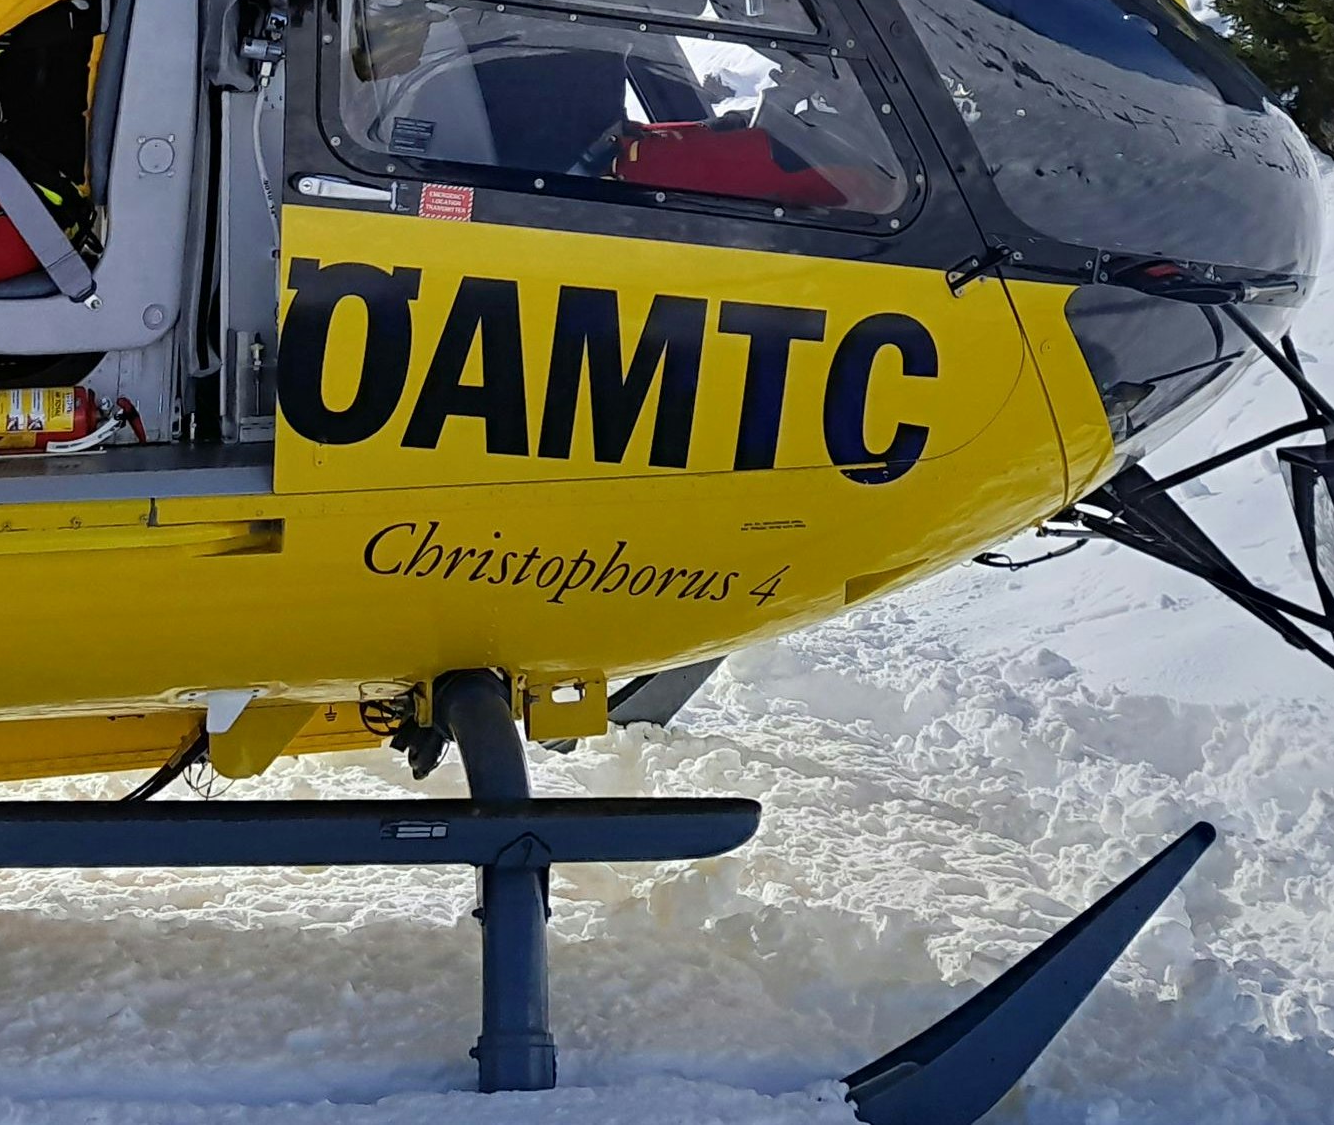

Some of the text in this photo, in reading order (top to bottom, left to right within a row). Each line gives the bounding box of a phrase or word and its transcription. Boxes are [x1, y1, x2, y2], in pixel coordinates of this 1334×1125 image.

[431, 198, 462, 206] LOCATION
[276, 256, 939, 485] ÖAMTC
[364, 521, 791, 607] Christophorus 4
